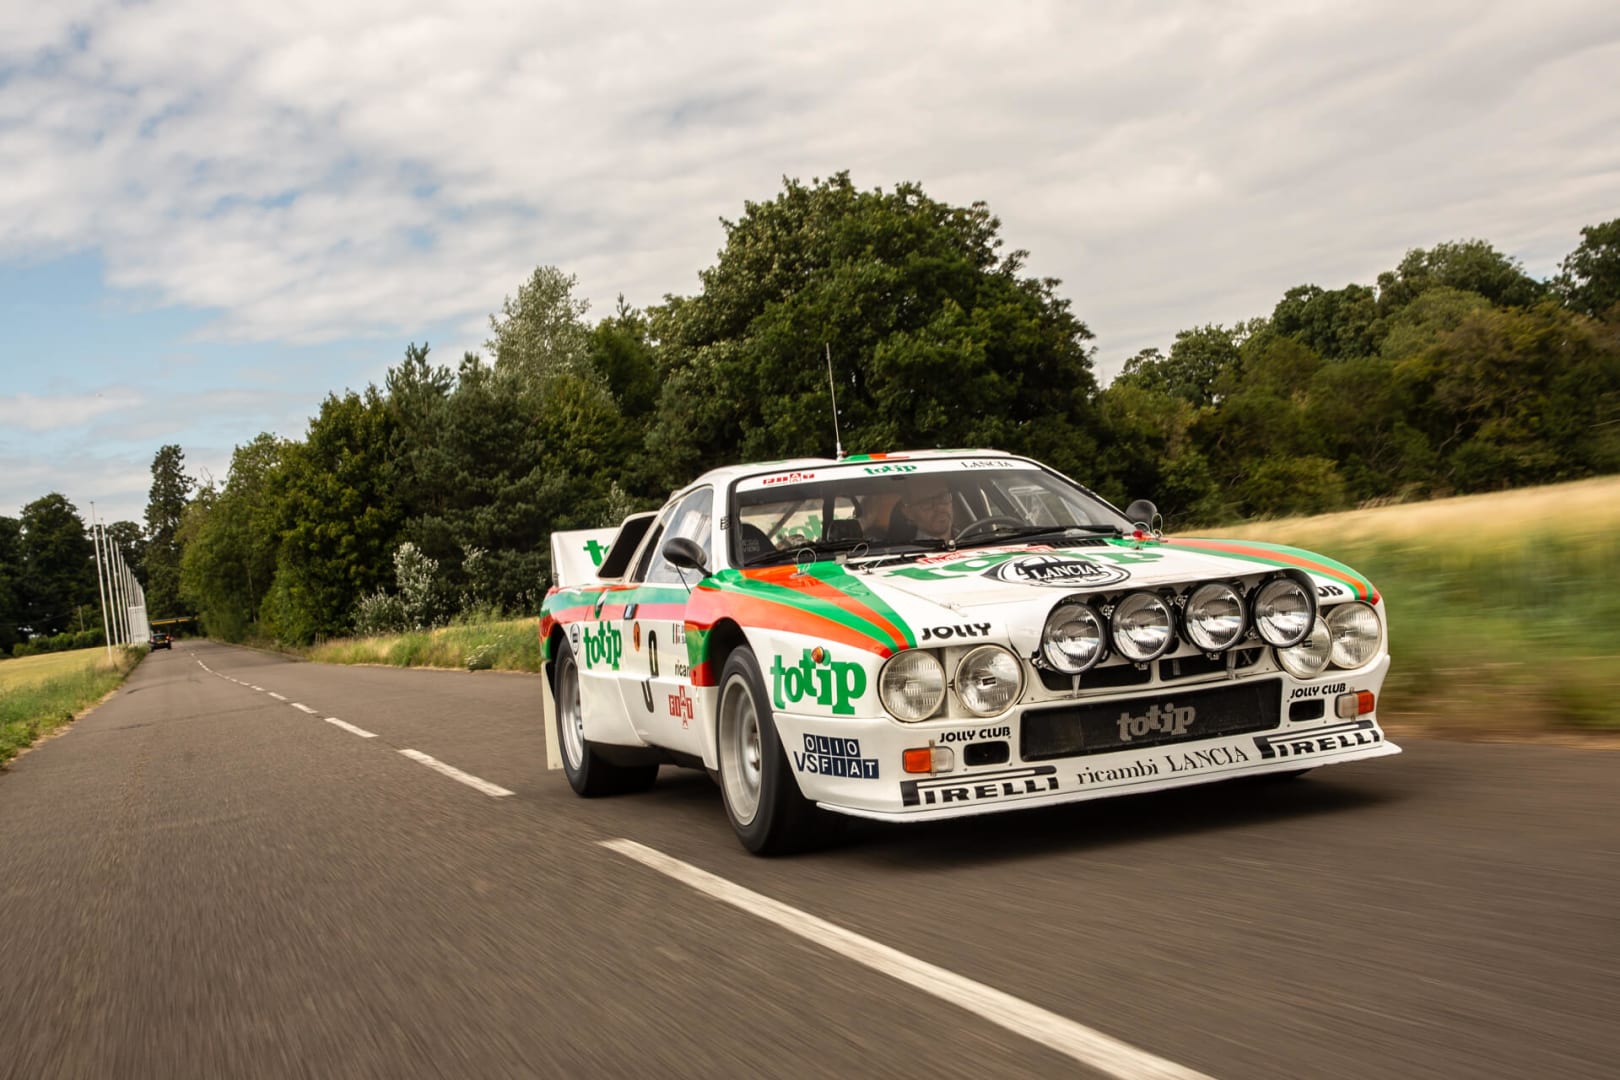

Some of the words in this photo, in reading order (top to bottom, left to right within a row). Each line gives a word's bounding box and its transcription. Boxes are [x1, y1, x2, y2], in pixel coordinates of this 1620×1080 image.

[863, 464, 918, 476] totip
[1030, 564, 1098, 581] LANCIA
[583, 620, 622, 670] totip
[921, 622, 992, 641] JOLLY
[770, 648, 867, 715] totip
[1290, 685, 1320, 699] JOLLY
[1322, 682, 1346, 695] CLUB
[939, 729, 976, 744] JOLLY
[979, 725, 1011, 740] CLUB
[1116, 702, 1197, 742] totip
[804, 733, 860, 756] OLIO
[1253, 720, 1380, 759] PIRELLI
[1076, 757, 1159, 785] ricambi
[1165, 746, 1249, 773] LANCIA
[900, 765, 1060, 808] PIRELLI
